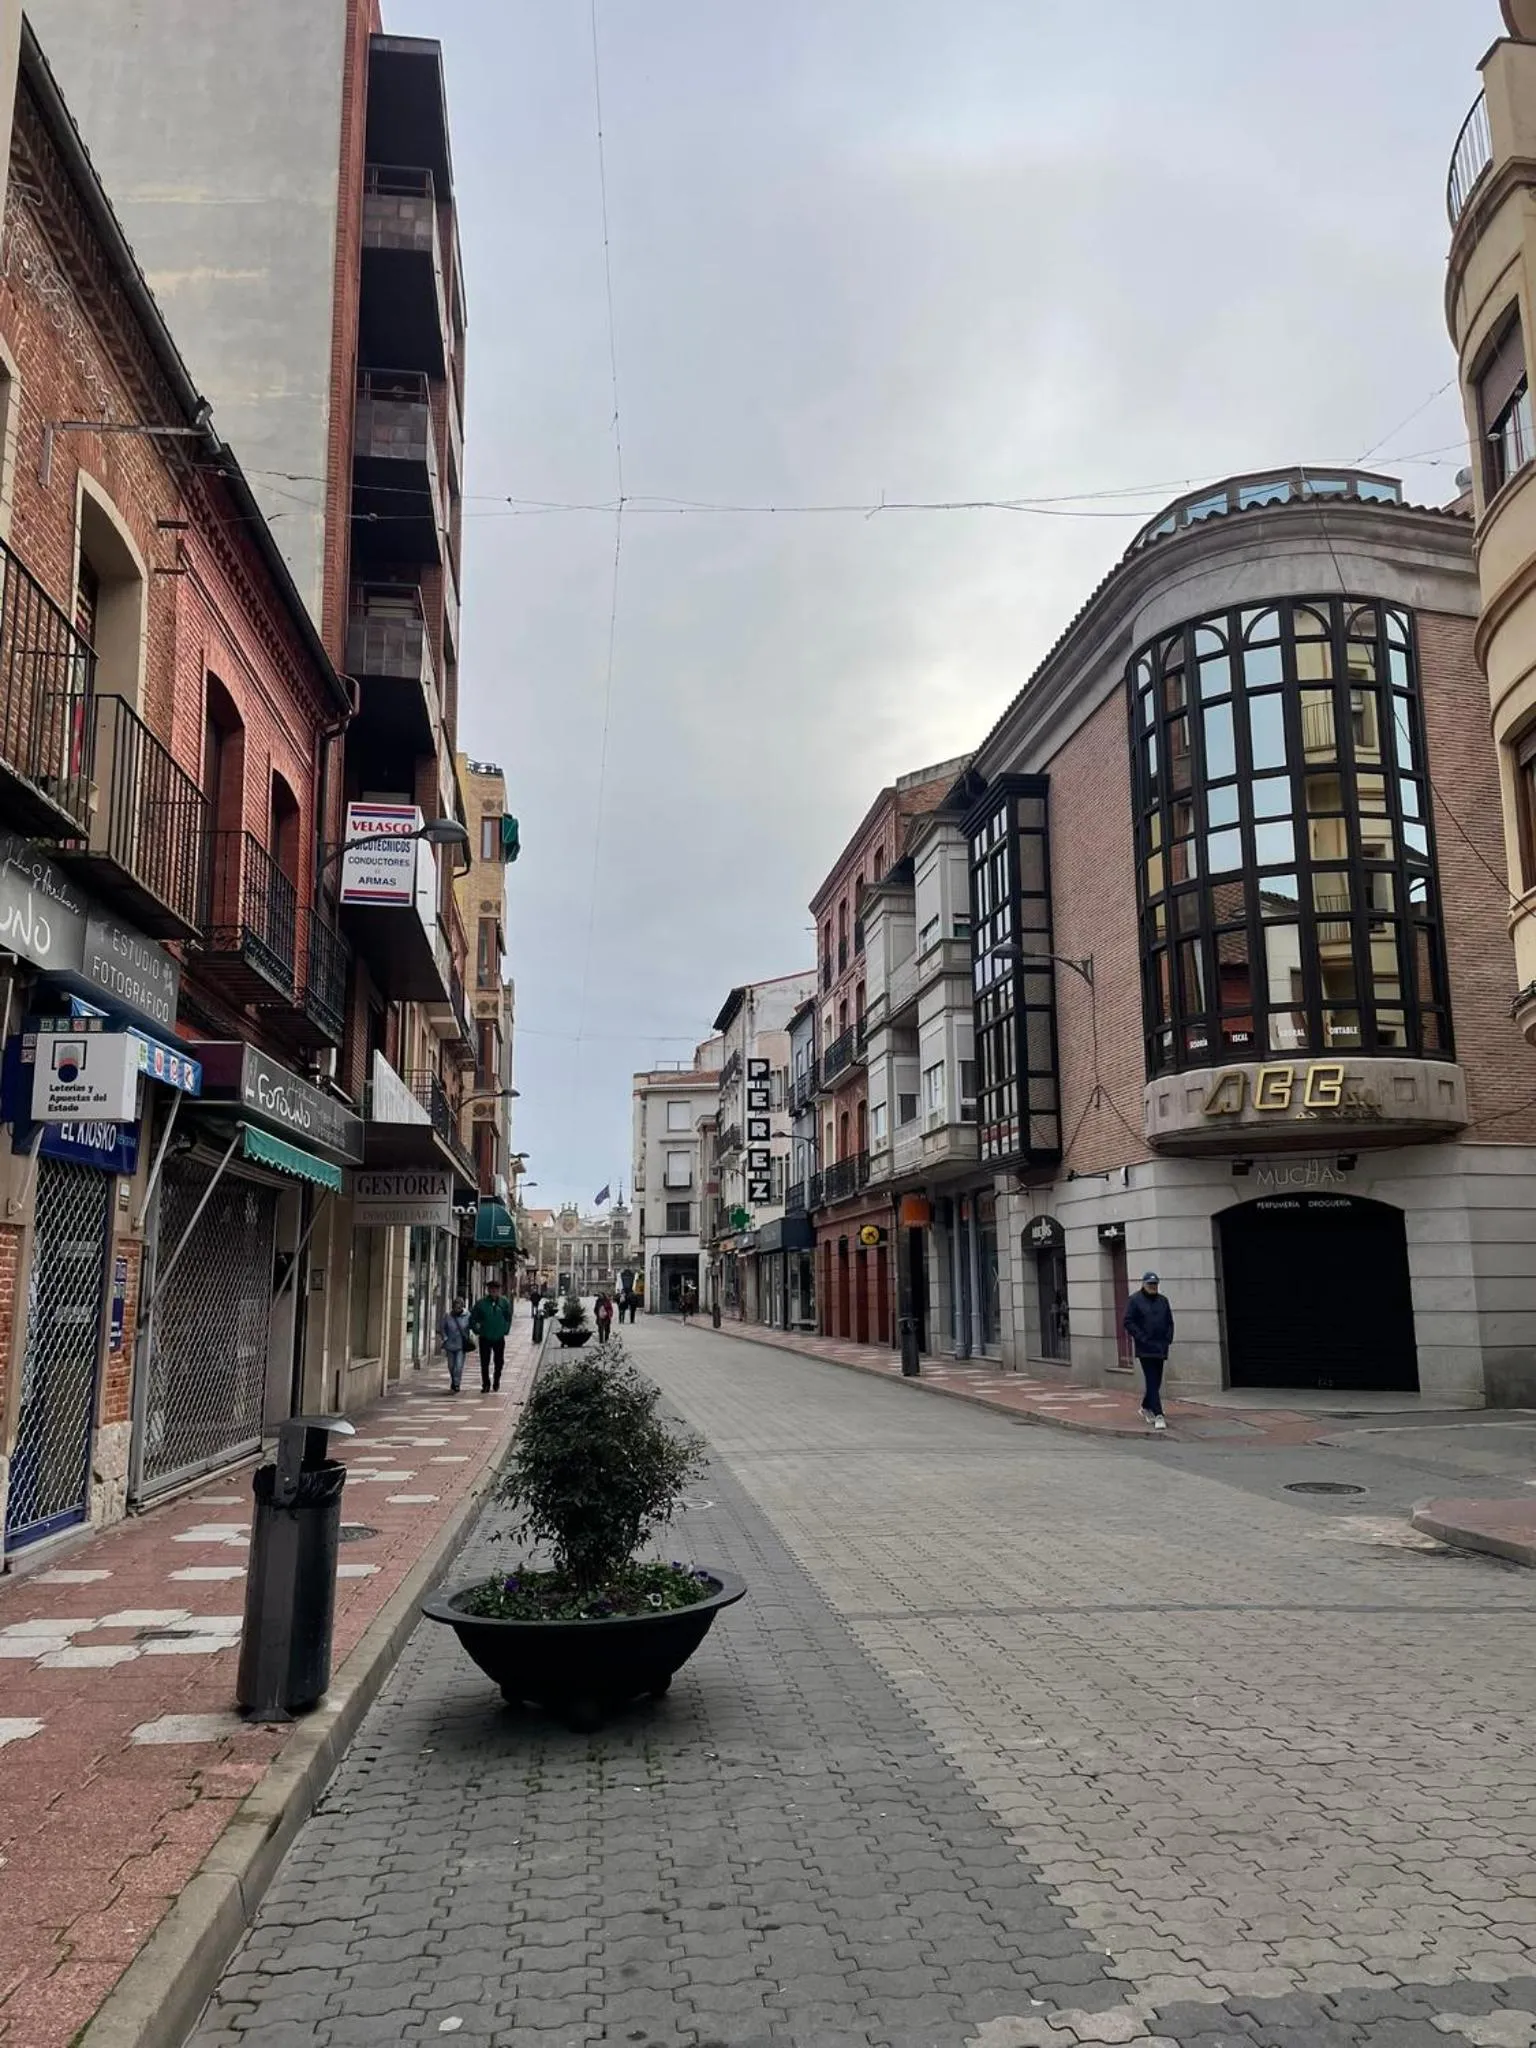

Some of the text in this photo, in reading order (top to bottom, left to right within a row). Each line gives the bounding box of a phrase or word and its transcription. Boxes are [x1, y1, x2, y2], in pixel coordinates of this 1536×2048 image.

[352, 820, 412, 834] VELASCO
[348, 856, 410, 867] CONDUCTORES
[358, 876, 397, 886] ARMAS
[112, 928, 160, 980] ESTUDIO
[93, 1093, 108, 1102] del
[48, 1103, 79, 1112] Estado
[750, 1061, 769, 1199] PEREZ
[61, 1121, 75, 1142] EL
[77, 1122, 117, 1152] KIOSKO
